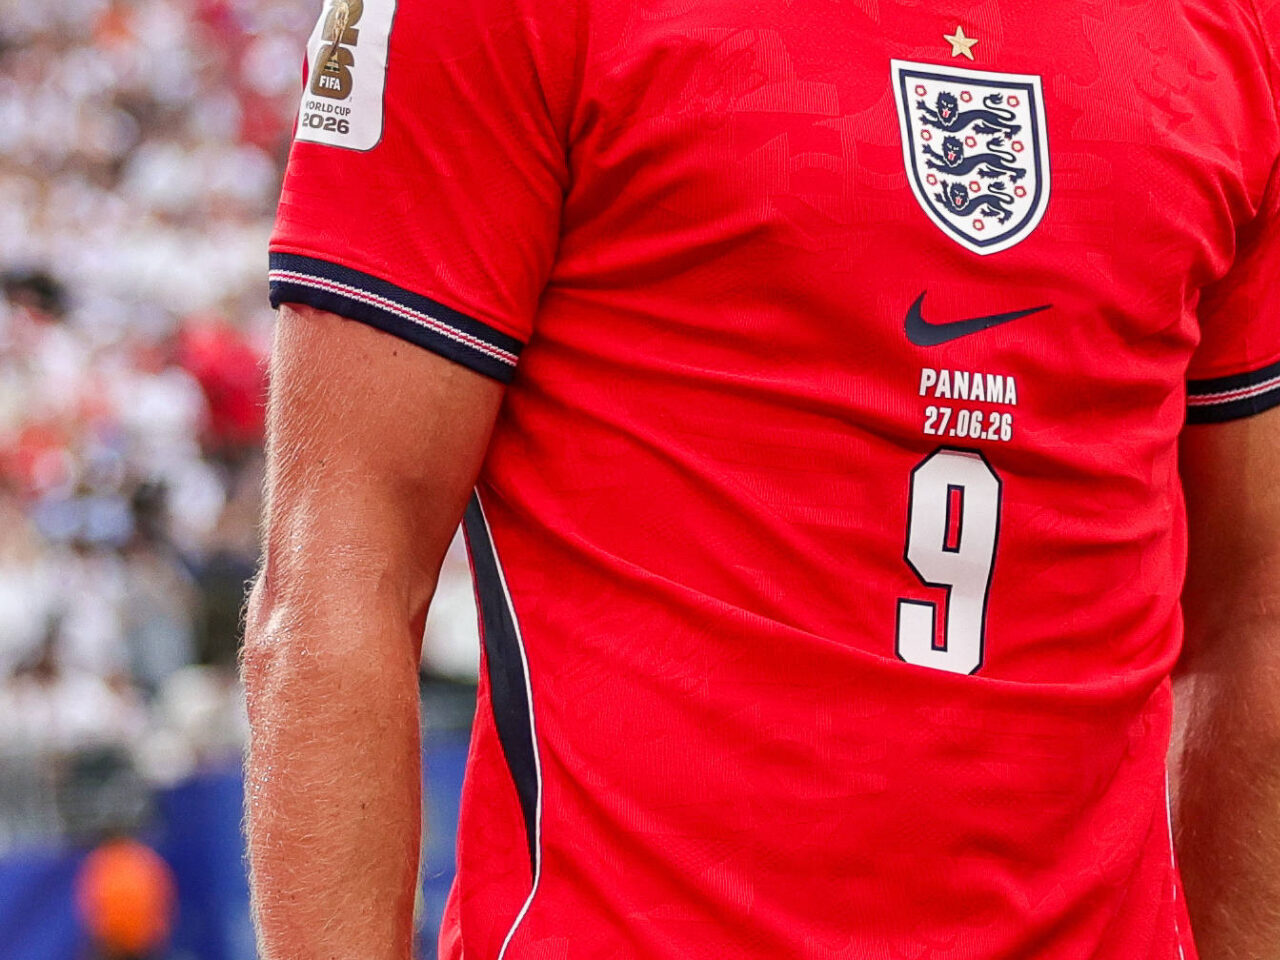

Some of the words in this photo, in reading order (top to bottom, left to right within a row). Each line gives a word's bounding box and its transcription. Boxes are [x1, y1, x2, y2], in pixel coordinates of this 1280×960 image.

[318, 75, 342, 91] FIFA
[302, 112, 350, 135] 2026
[334, 105, 352, 117] CUP
[919, 367, 1017, 406] PANAMA
[923, 405, 1013, 442] 27.06.26
[896, 445, 1003, 677] 9
